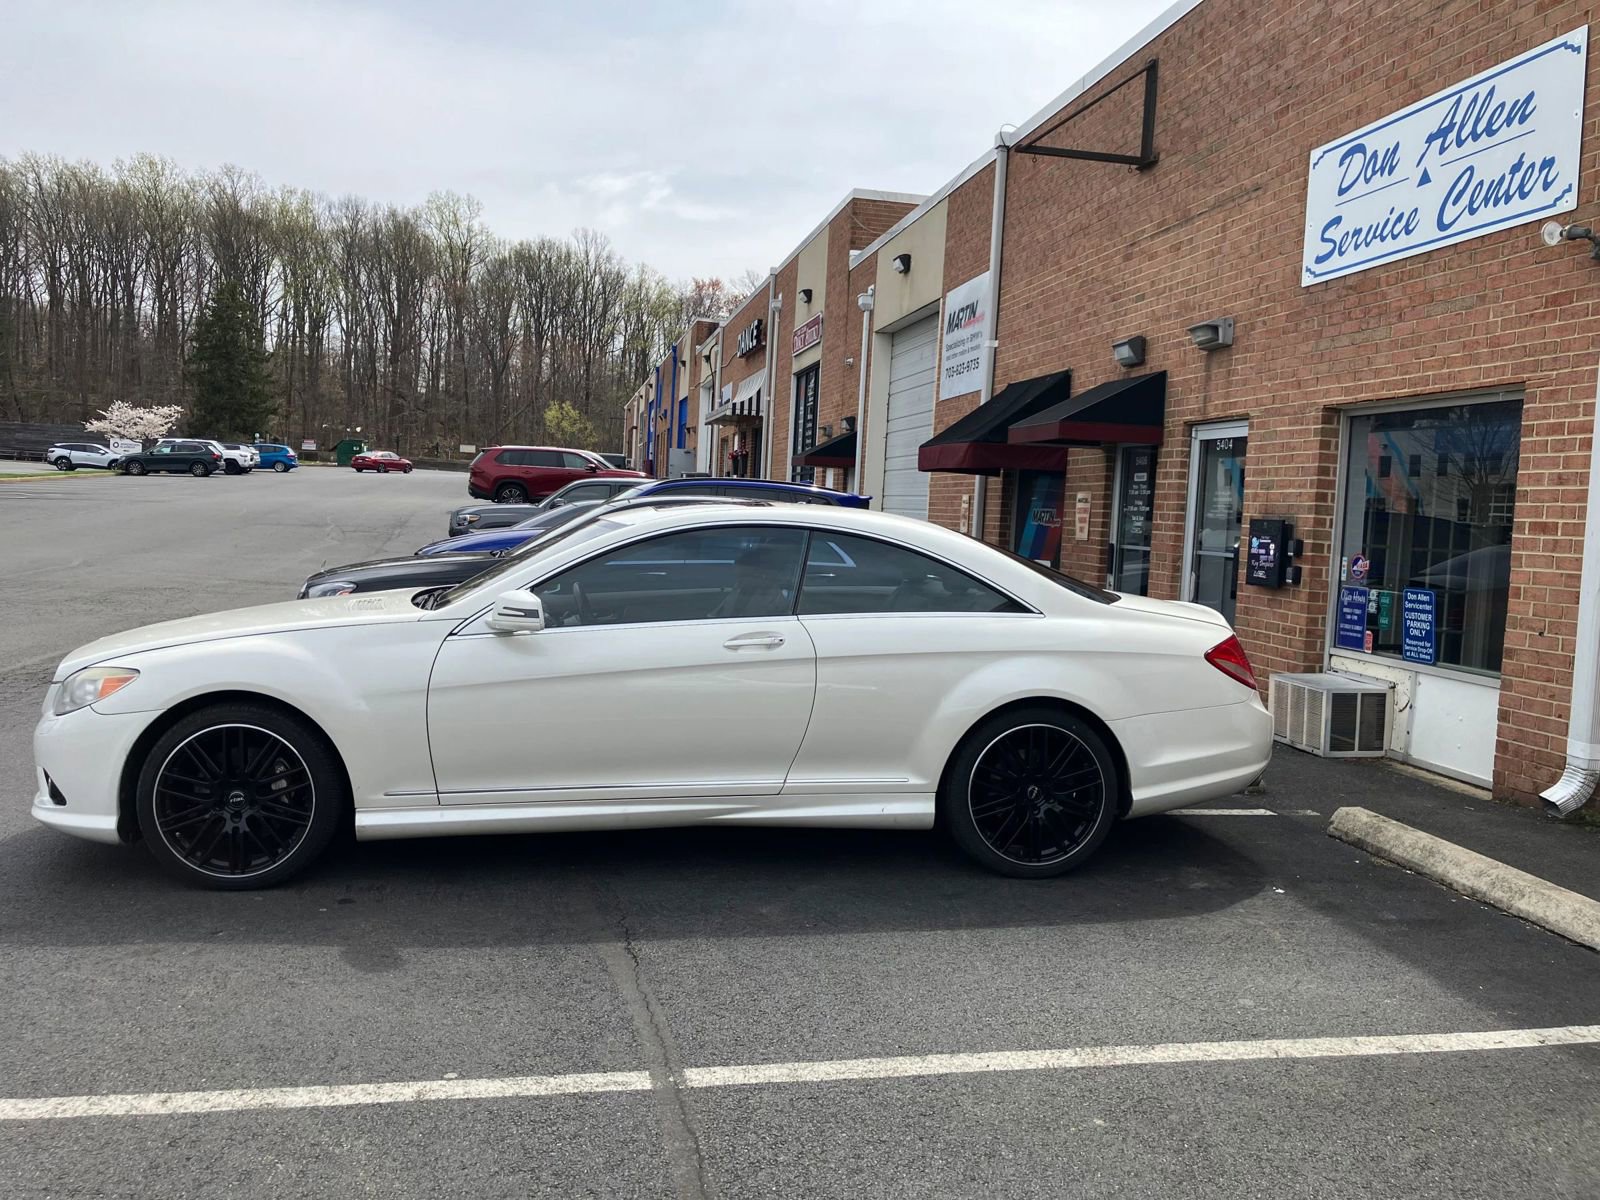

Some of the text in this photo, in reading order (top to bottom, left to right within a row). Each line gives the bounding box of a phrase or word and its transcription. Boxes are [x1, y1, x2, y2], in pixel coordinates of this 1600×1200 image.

[1338, 85, 1537, 196] Don Allen
[1314, 152, 1559, 264] Service Center
[946, 300, 978, 335] MARTIN
[737, 319, 760, 358] DANCE
[945, 357, 980, 380] 703-823-9735
[1216, 439, 1233, 450] 5404
[1407, 592, 1430, 602] Don Allen
[1405, 601, 1432, 611] Servicenter
[1404, 611, 1432, 622] CUSTOMER
[1406, 620, 1430, 630] PARKING
[1409, 628, 1426, 637] ONLY
[1406, 638, 1424, 647] Reserved
[1411, 650, 1419, 658] ALL
